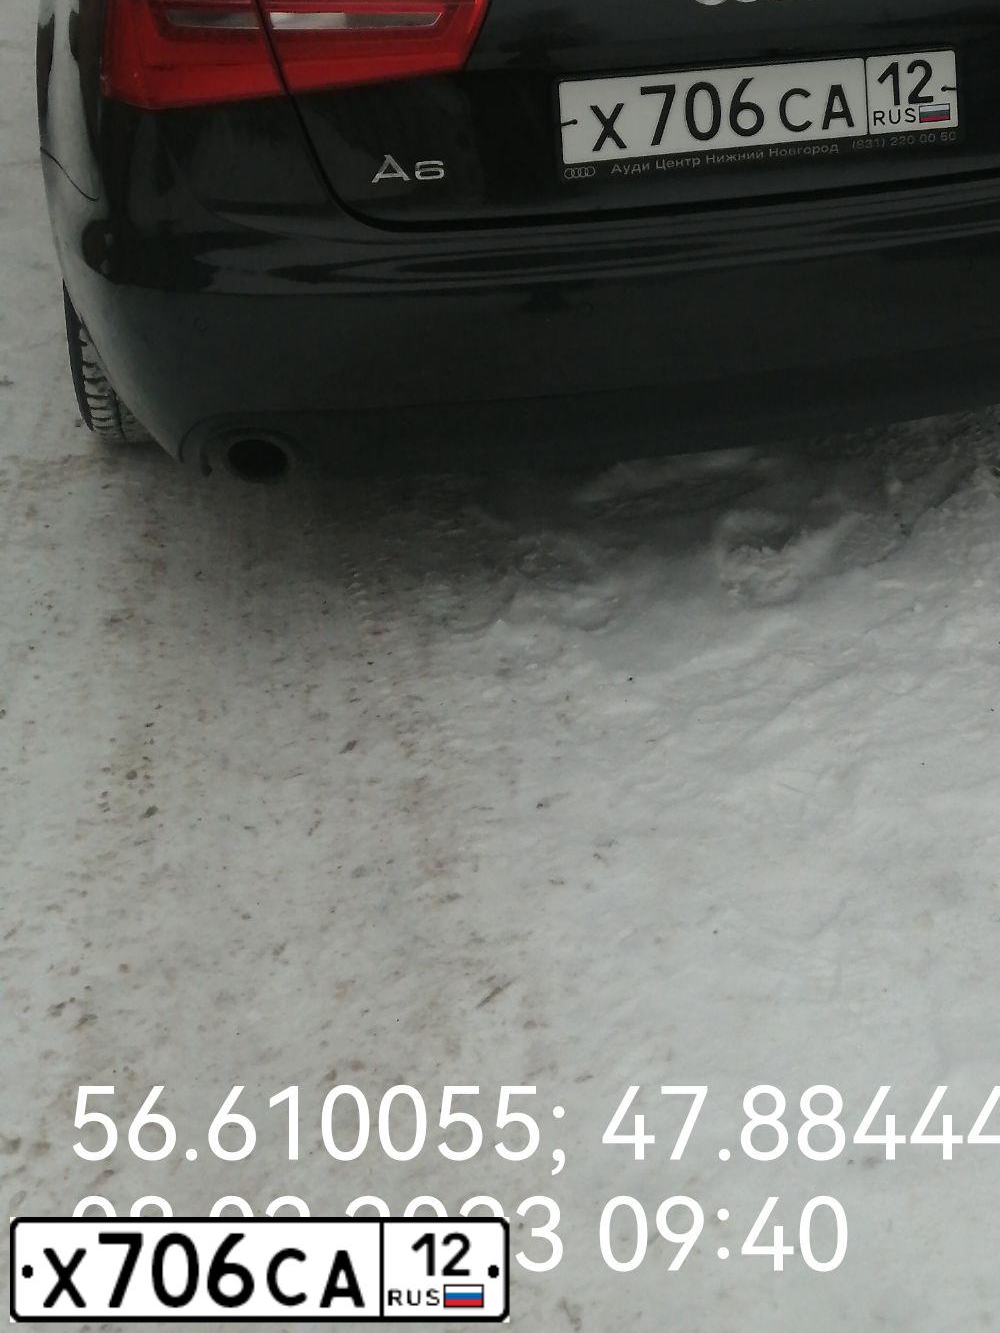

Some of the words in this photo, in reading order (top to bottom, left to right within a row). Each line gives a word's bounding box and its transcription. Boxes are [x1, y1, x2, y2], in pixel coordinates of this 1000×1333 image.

[877, 60, 934, 105] 12
[873, 108, 917, 127] RUS
[371, 154, 445, 183] A6
[610, 161, 651, 175] Ауди
[656, 156, 701, 170] Центр
[769, 144, 839, 158] Новгород
